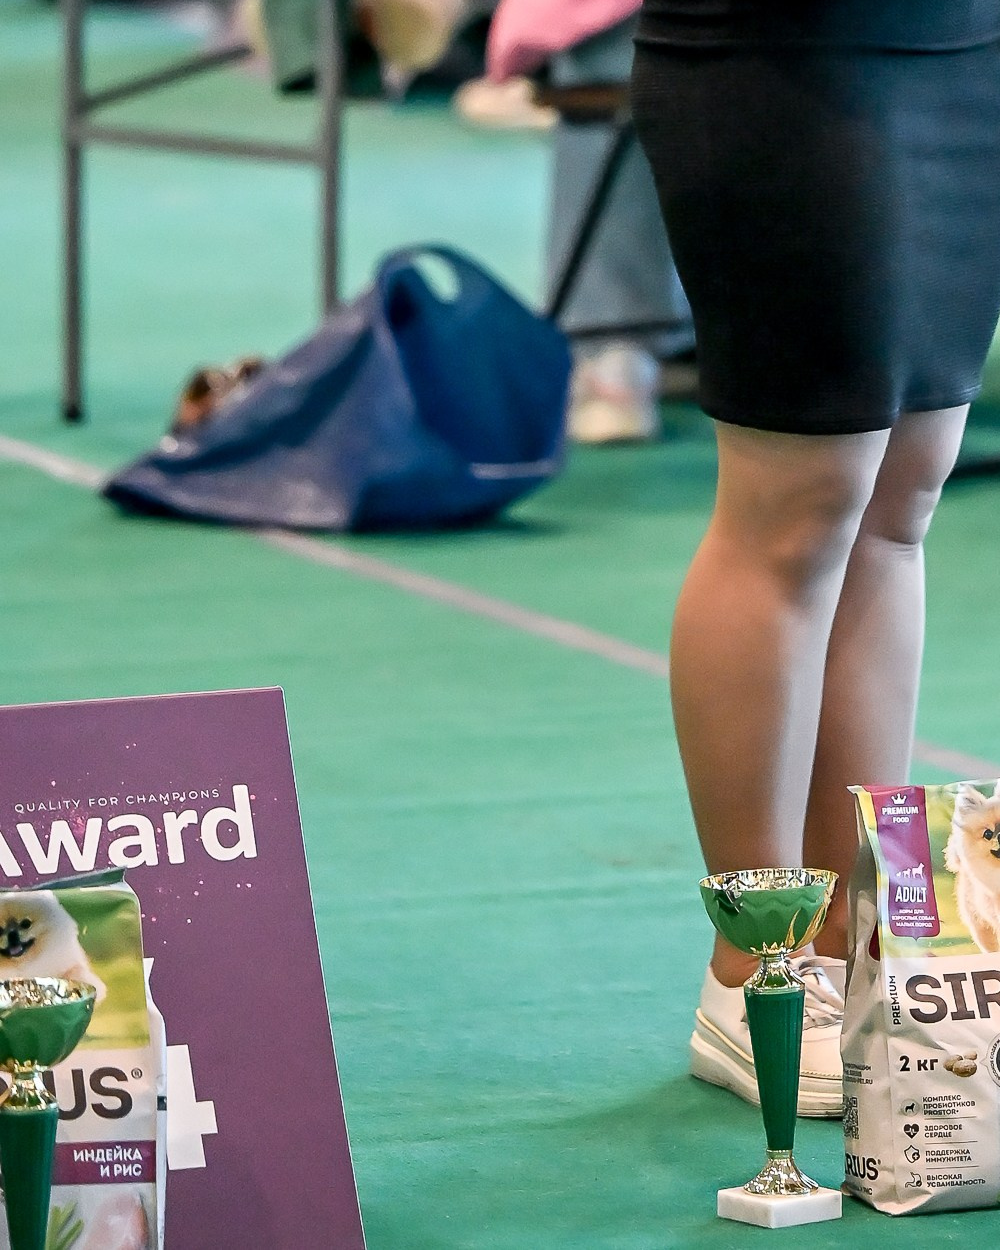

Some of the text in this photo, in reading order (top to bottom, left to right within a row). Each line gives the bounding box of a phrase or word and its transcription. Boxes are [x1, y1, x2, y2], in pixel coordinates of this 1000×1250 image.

[14, 788, 221, 814] QUALITY FOR CHAMPIONS
[881, 806, 919, 816] PREMIUM
[892, 816, 910, 824] FOOD
[894, 885, 927, 903] ADULT
[888, 975, 902, 1026] PREMIUM
[899, 1055, 910, 1072] 2
[922, 1094, 962, 1103] КОМПЛЕКС
[923, 1101, 976, 1109] ПРОБИОТИКОВ
[924, 1124, 963, 1132] ЗДОРОВОЕ
[73, 1146, 143, 1163] ИНДЕЙКА
[925, 1148, 971, 1156] ПОДДЕРЖКА
[925, 1155, 972, 1163] ИММУНИТЕТА
[100, 1163, 142, 1178] И РИС
[845, 1152, 879, 1180] RIUS
[926, 1173, 963, 1181] ВЫСОКАЯ
[926, 1179, 986, 1188] УСВАИВАЕМОСТЬ
